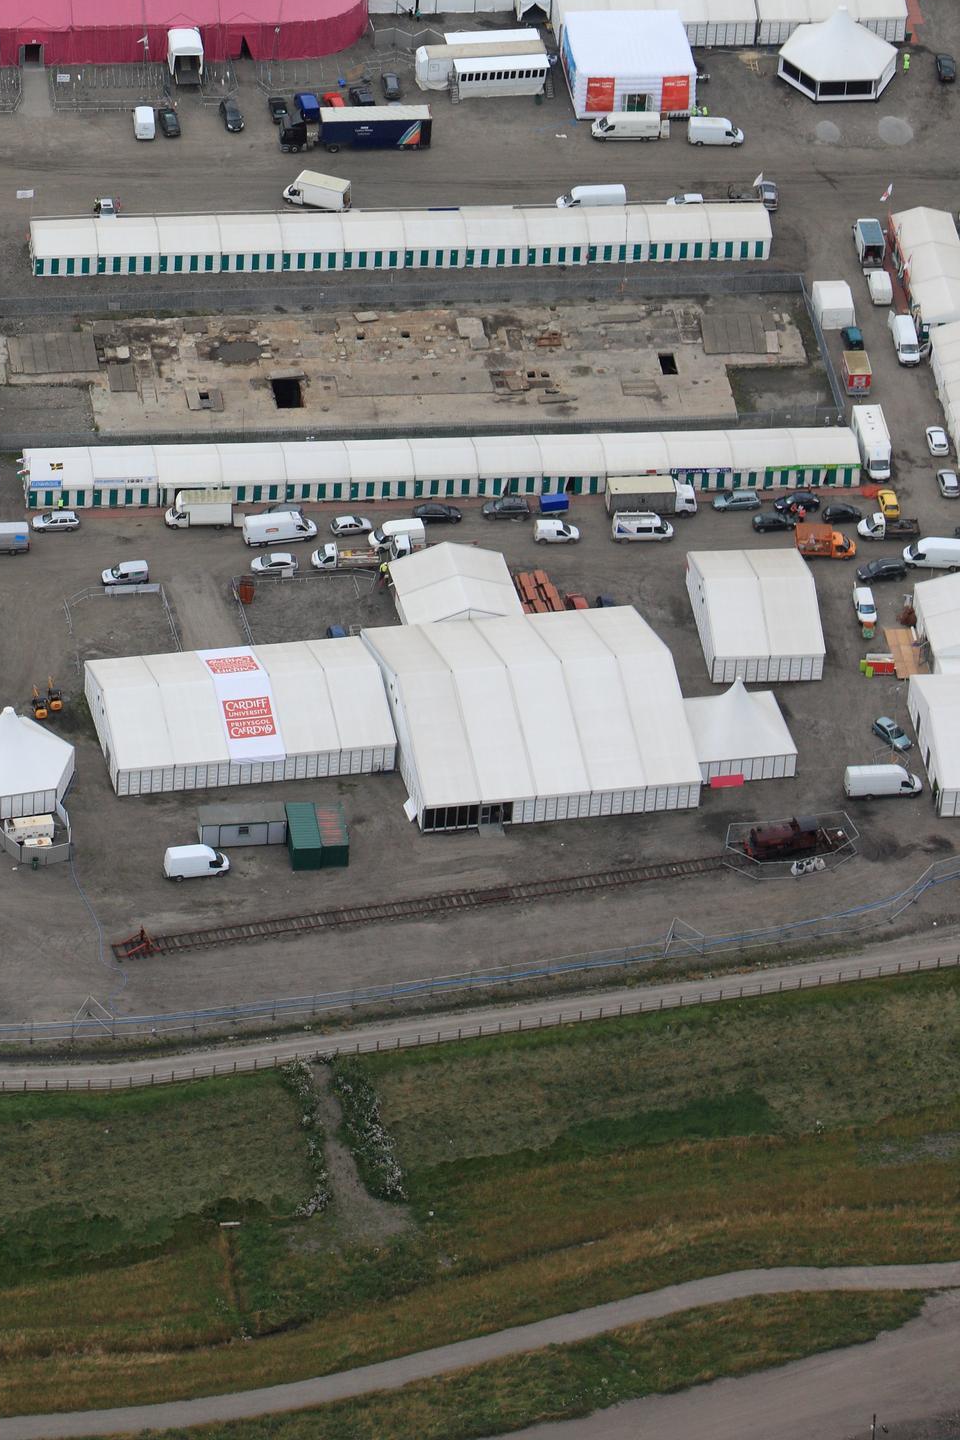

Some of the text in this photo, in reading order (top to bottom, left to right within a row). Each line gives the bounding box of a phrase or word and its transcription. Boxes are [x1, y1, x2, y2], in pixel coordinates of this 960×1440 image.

[225, 699, 267, 711] CARDIFF
[228, 708, 268, 717] UNIVERSITY
[230, 719, 271, 727] PRIFYSGOL
